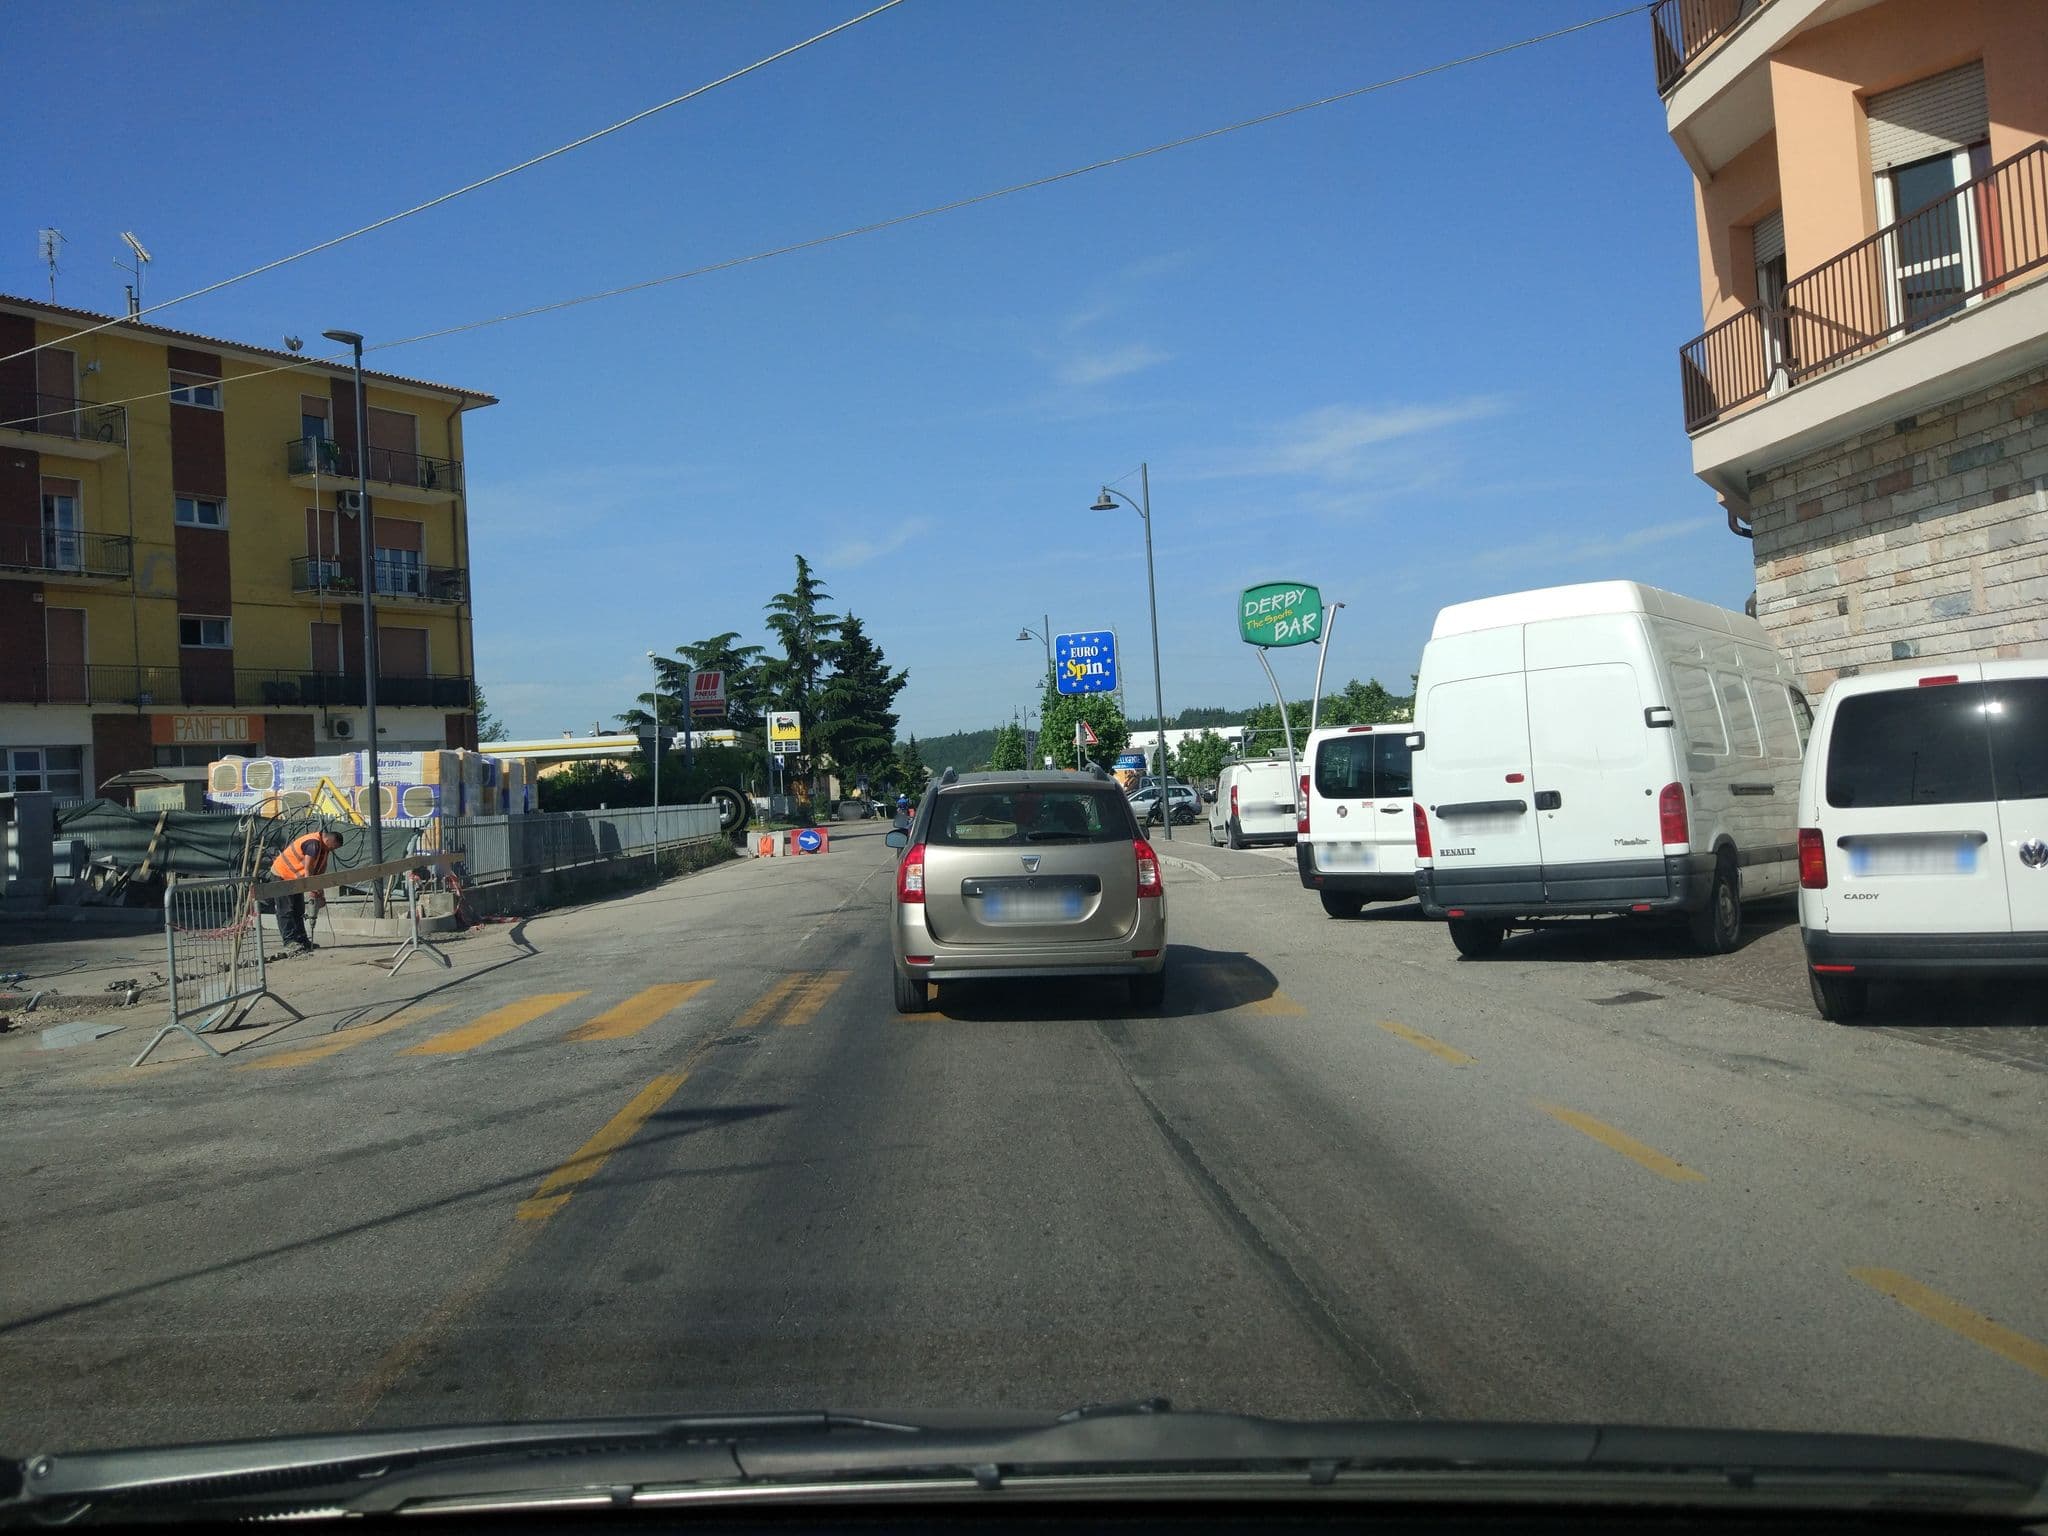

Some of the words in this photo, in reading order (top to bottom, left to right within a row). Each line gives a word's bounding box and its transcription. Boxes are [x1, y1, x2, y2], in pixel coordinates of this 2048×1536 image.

[1245, 588, 1307, 617] DERBY
[1246, 619, 1264, 631] The
[1274, 612, 1317, 641] BAR
[1070, 645, 1099, 658] EURO
[1066, 658, 1104, 681] Spin
[175, 716, 249, 740] PANIFICIO
[1439, 847, 1476, 857] RENAULT
